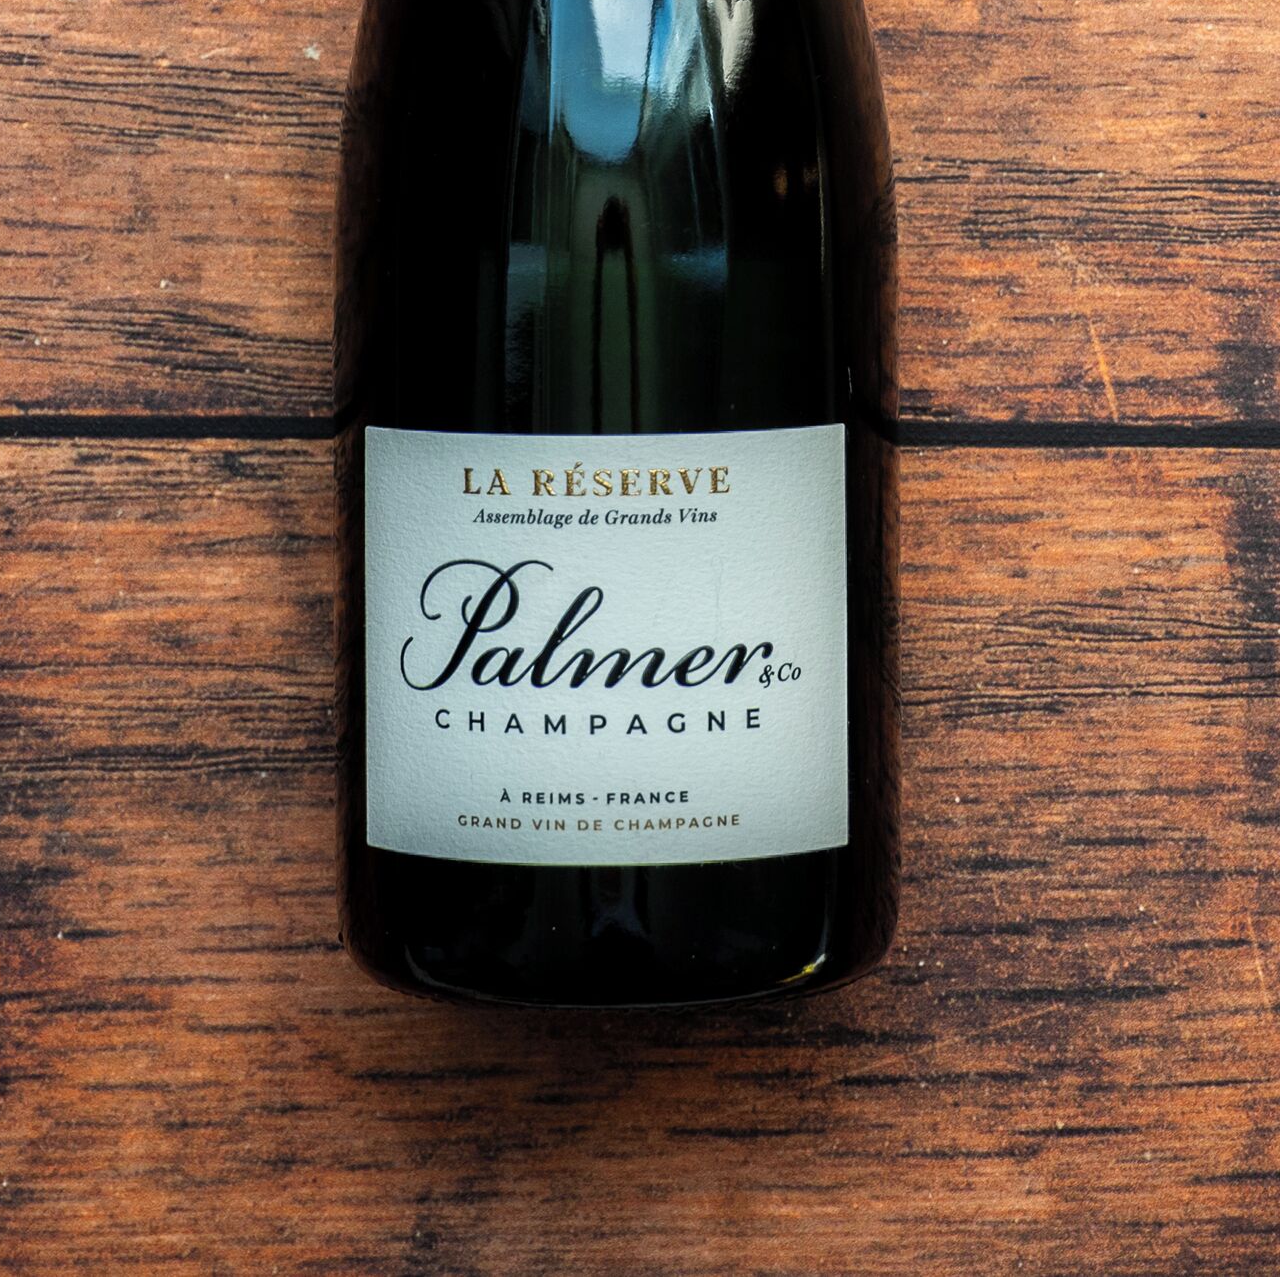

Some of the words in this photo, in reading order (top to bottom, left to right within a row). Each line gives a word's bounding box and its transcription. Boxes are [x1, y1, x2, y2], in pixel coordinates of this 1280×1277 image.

[462, 467, 512, 496] LA
[531, 460, 731, 497] RÉSERVE
[472, 508, 574, 530] Assemblage
[578, 509, 599, 525] de
[604, 508, 672, 525] Grands
[678, 507, 718, 523] Vins
[400, 558, 774, 692] Palmer
[434, 707, 762, 736] CHAMPAGNE
[499, 788, 511, 804] À
[521, 791, 586, 805] REIMS
[606, 789, 690, 805] FRANCE
[457, 814, 522, 830] GRAND
[531, 818, 566, 831] VIN
[577, 819, 603, 832] DE
[613, 813, 741, 832] CHAMPAGNE
